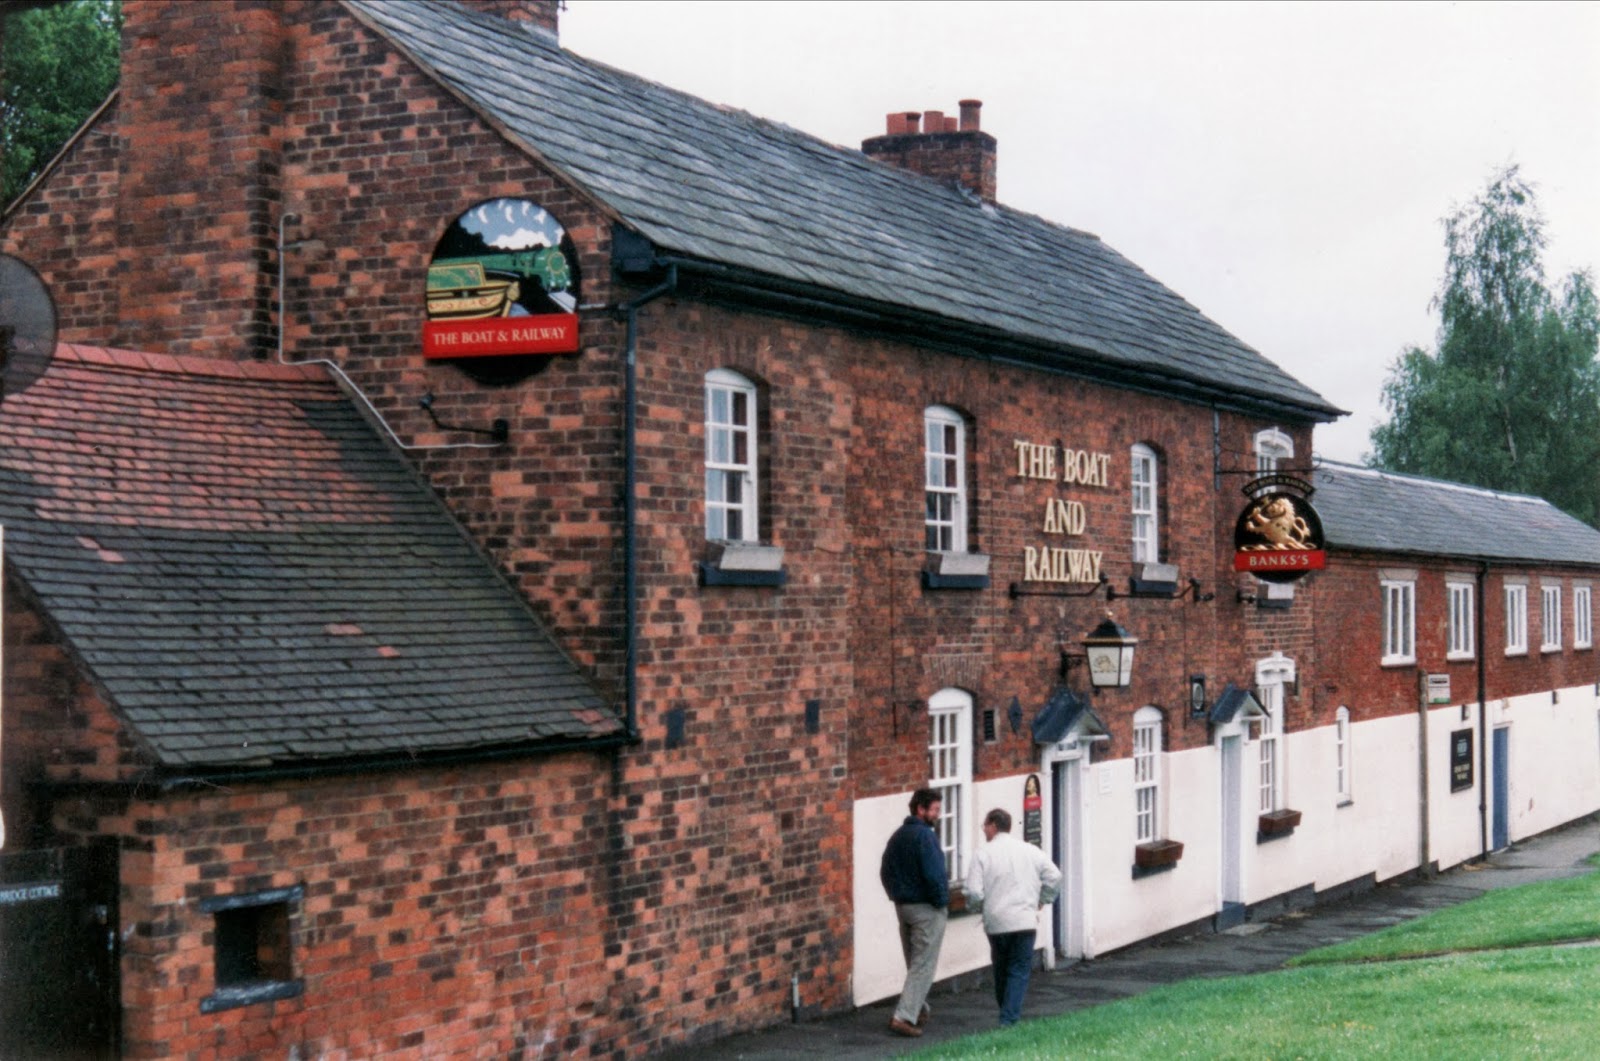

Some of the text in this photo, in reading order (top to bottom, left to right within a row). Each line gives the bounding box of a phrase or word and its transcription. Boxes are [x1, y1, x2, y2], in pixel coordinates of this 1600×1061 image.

[433, 327, 567, 345] THE BOAT & RAILWAY
[1013, 440, 1111, 487] THE BOAT
[1043, 497, 1086, 535] AND
[1024, 546, 1103, 583] RAILWAY
[1249, 554, 1309, 567] BANKS'S
